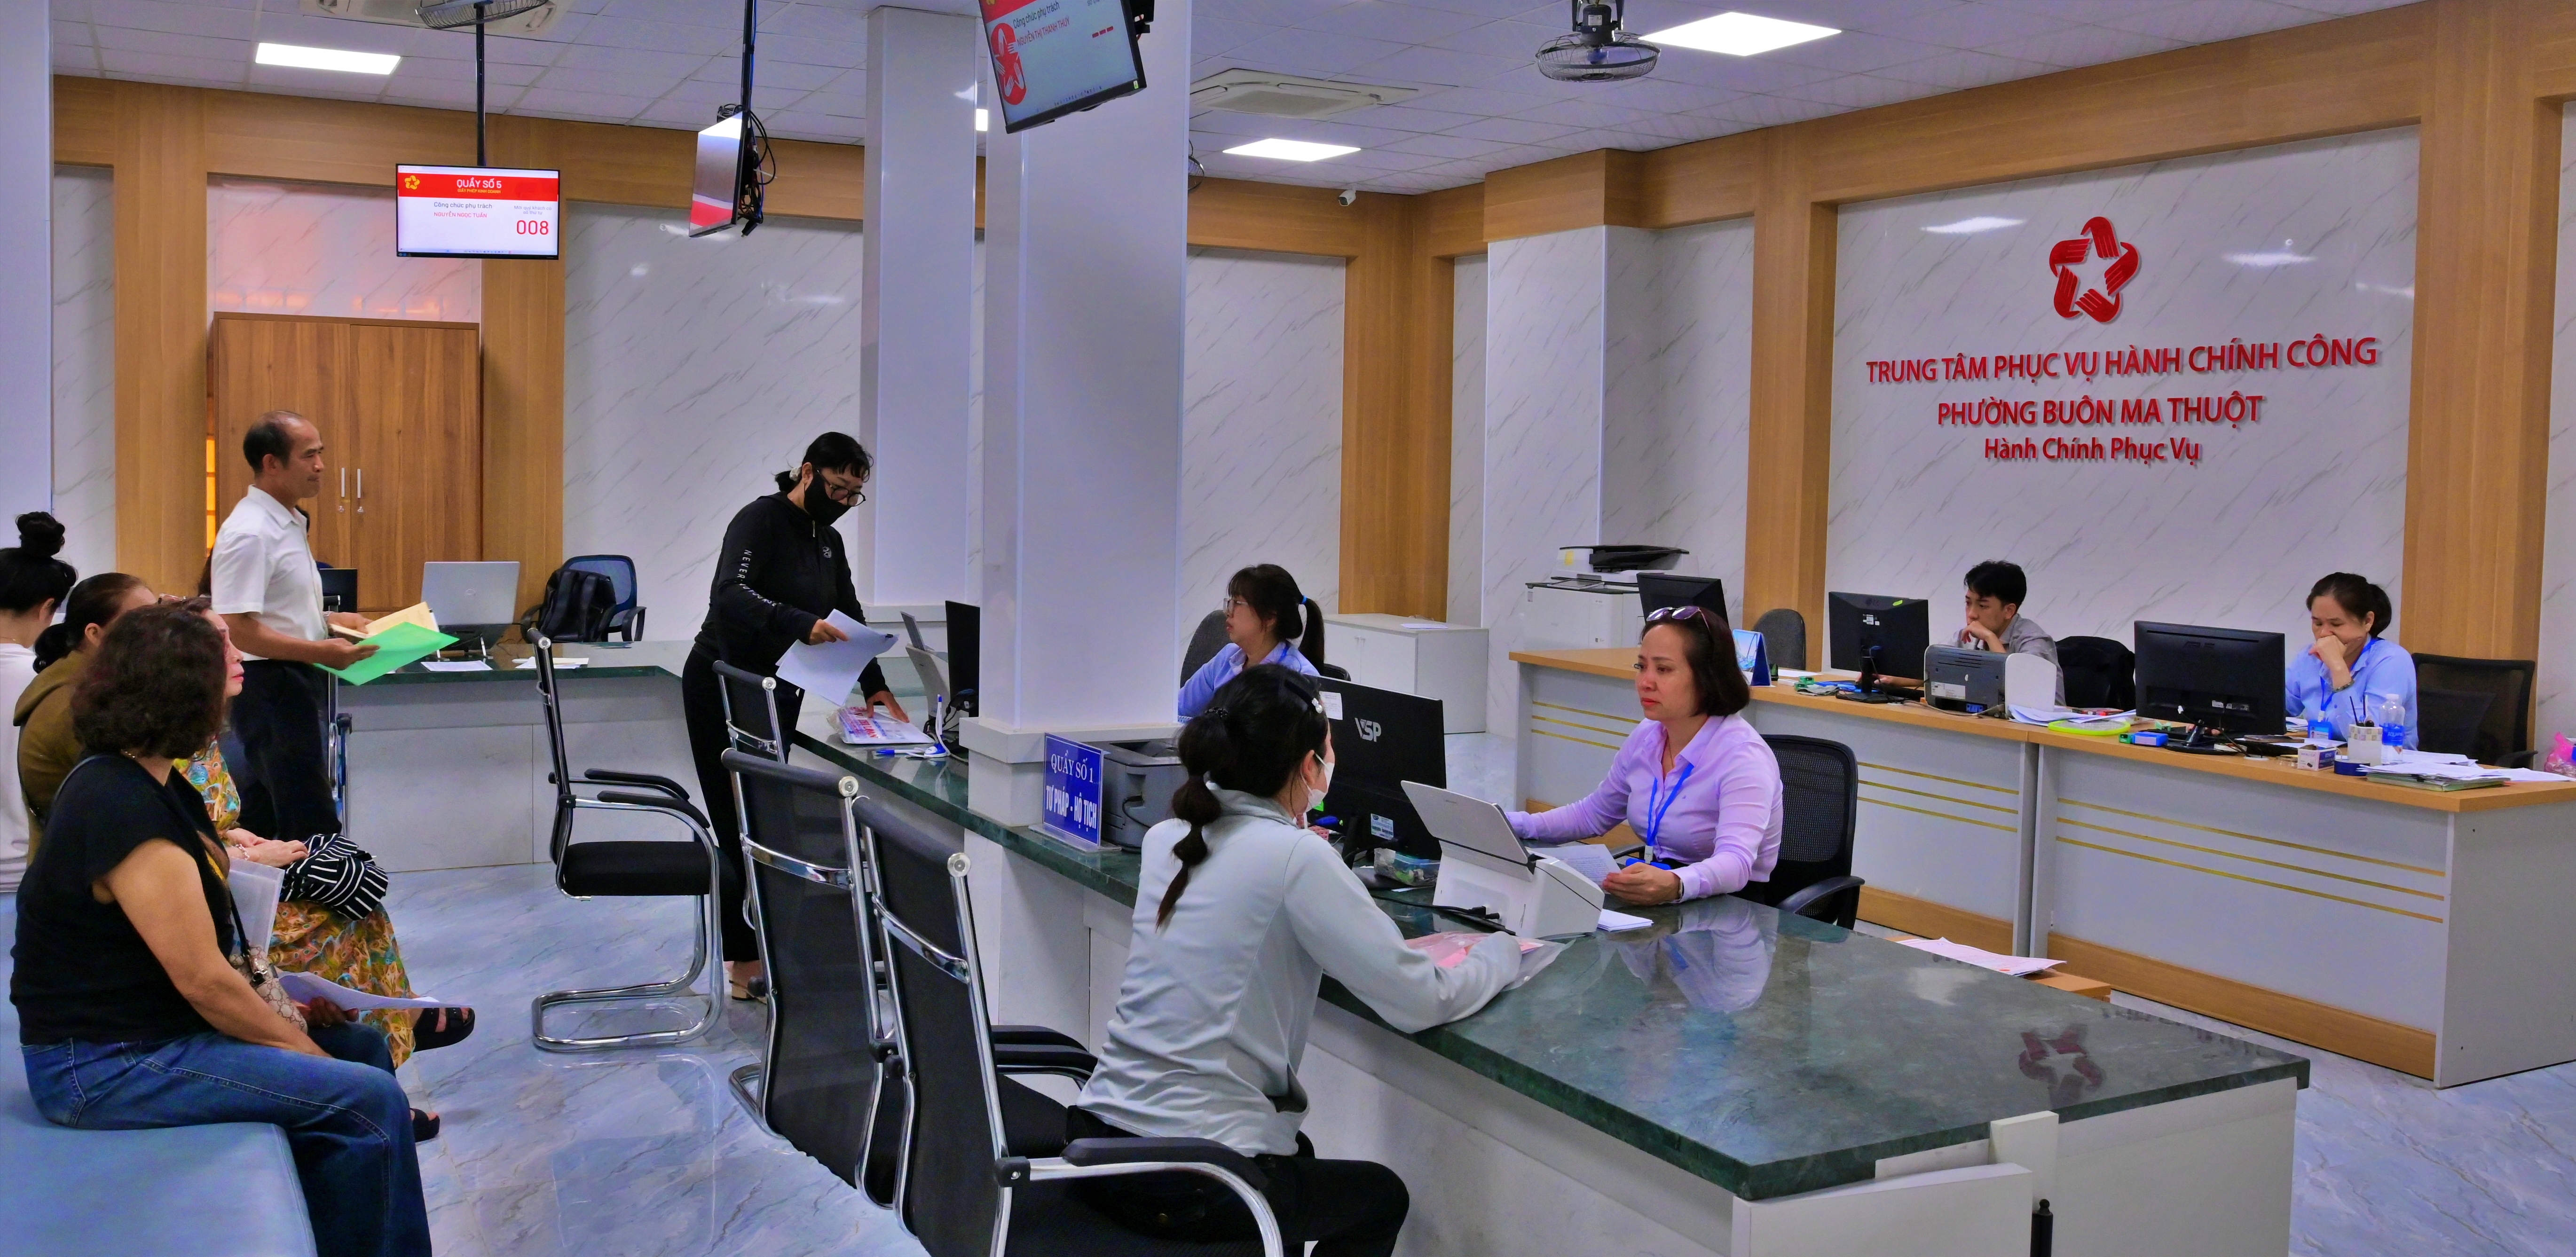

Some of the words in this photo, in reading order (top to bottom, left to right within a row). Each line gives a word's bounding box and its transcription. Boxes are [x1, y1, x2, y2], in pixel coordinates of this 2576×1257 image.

[1013, 18, 1026, 29] Công
[1025, 11, 1037, 23] chức
[1037, 8, 1047, 20] phụ
[1047, 0, 1060, 14] trách
[1034, 30, 1043, 39] THỊ
[1042, 22, 1058, 35] THANH
[482, 178, 495, 189] SỐ
[517, 220, 548, 235] 008
[1866, 359, 1938, 383] TRUNG
[1941, 353, 1987, 380] TÂM
[1994, 353, 2059, 384] PHỤC
[2064, 351, 2098, 382] VỤ
[2105, 345, 2182, 375] HÀNH
[2189, 338, 2278, 372] CHÍNH
[2287, 333, 2376, 367] CÔNG
[1938, 396, 2037, 425] PHƯỜNG
[2043, 395, 2113, 424] BUÔN
[2120, 398, 2162, 423] MA
[2167, 390, 2264, 429] THUỘT
[1985, 437, 2037, 459] Hành
[2042, 437, 2103, 459] Chính
[2111, 437, 2165, 464] Phục
[2170, 437, 2199, 465] Vụ
[737, 550, 752, 579] NEVER
[1355, 717, 1381, 742] VSP
[1051, 750, 1074, 776] QUẦY
[1076, 758, 1087, 780] SỐ
[1089, 768, 1093, 783] 1
[1046, 785, 1054, 811] TƯ
[1054, 786, 1069, 817] PHÁP
[1074, 792, 1082, 829] HỘ
[1084, 799, 1097, 832] TỊCH
